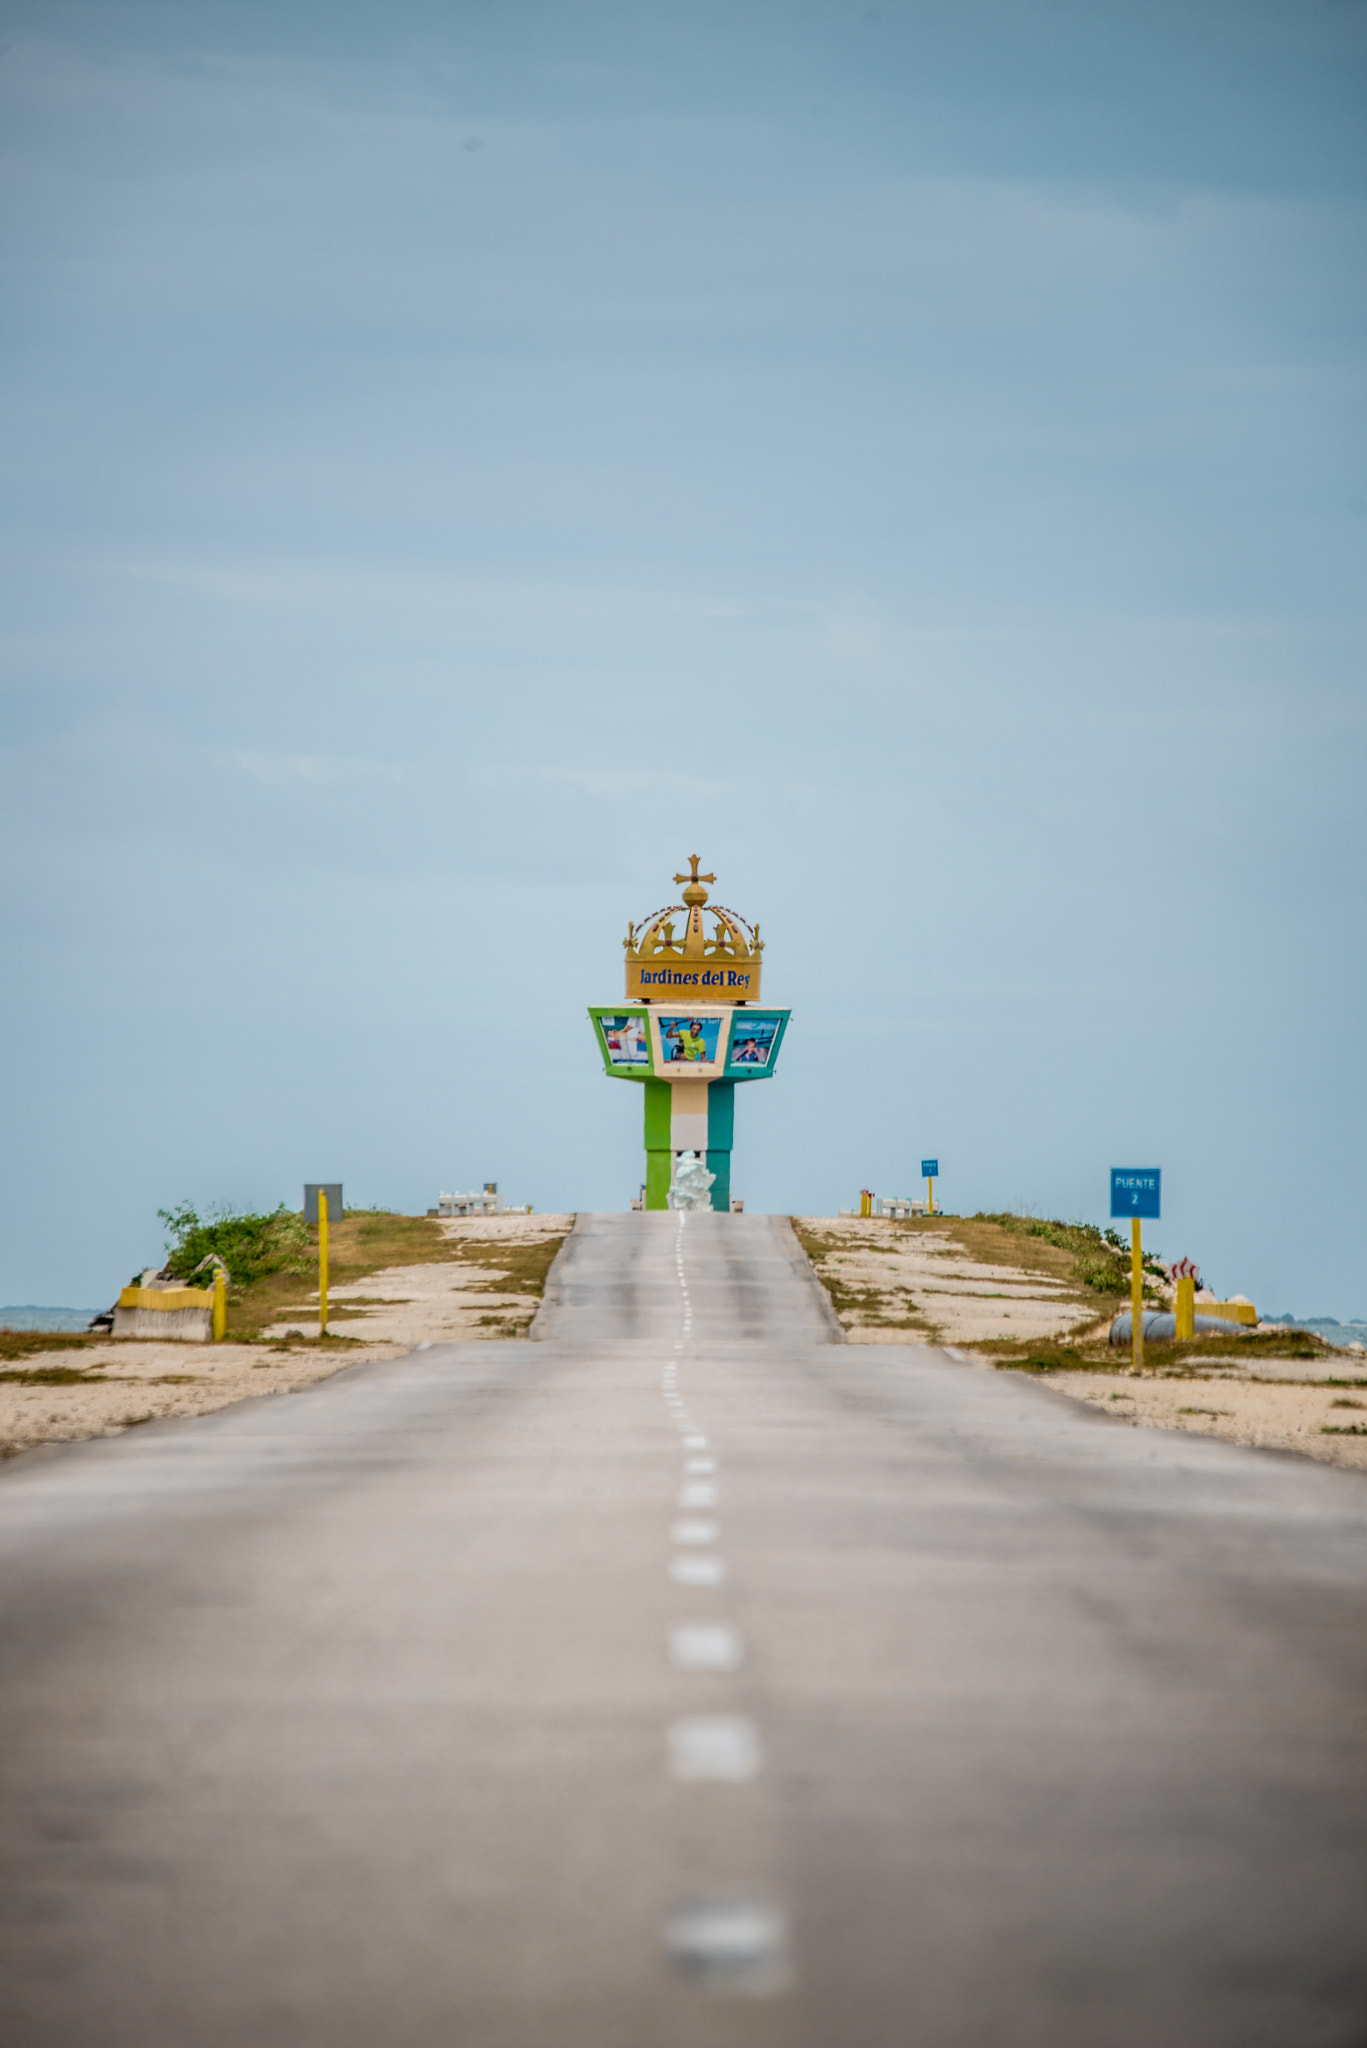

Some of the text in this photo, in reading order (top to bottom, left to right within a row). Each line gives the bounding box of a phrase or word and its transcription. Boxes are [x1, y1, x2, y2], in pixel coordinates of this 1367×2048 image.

[640, 968, 750, 989] Jardines del Rey
[1115, 1177, 1155, 1190] PUENTE
[1131, 1192, 1138, 1205] 2
